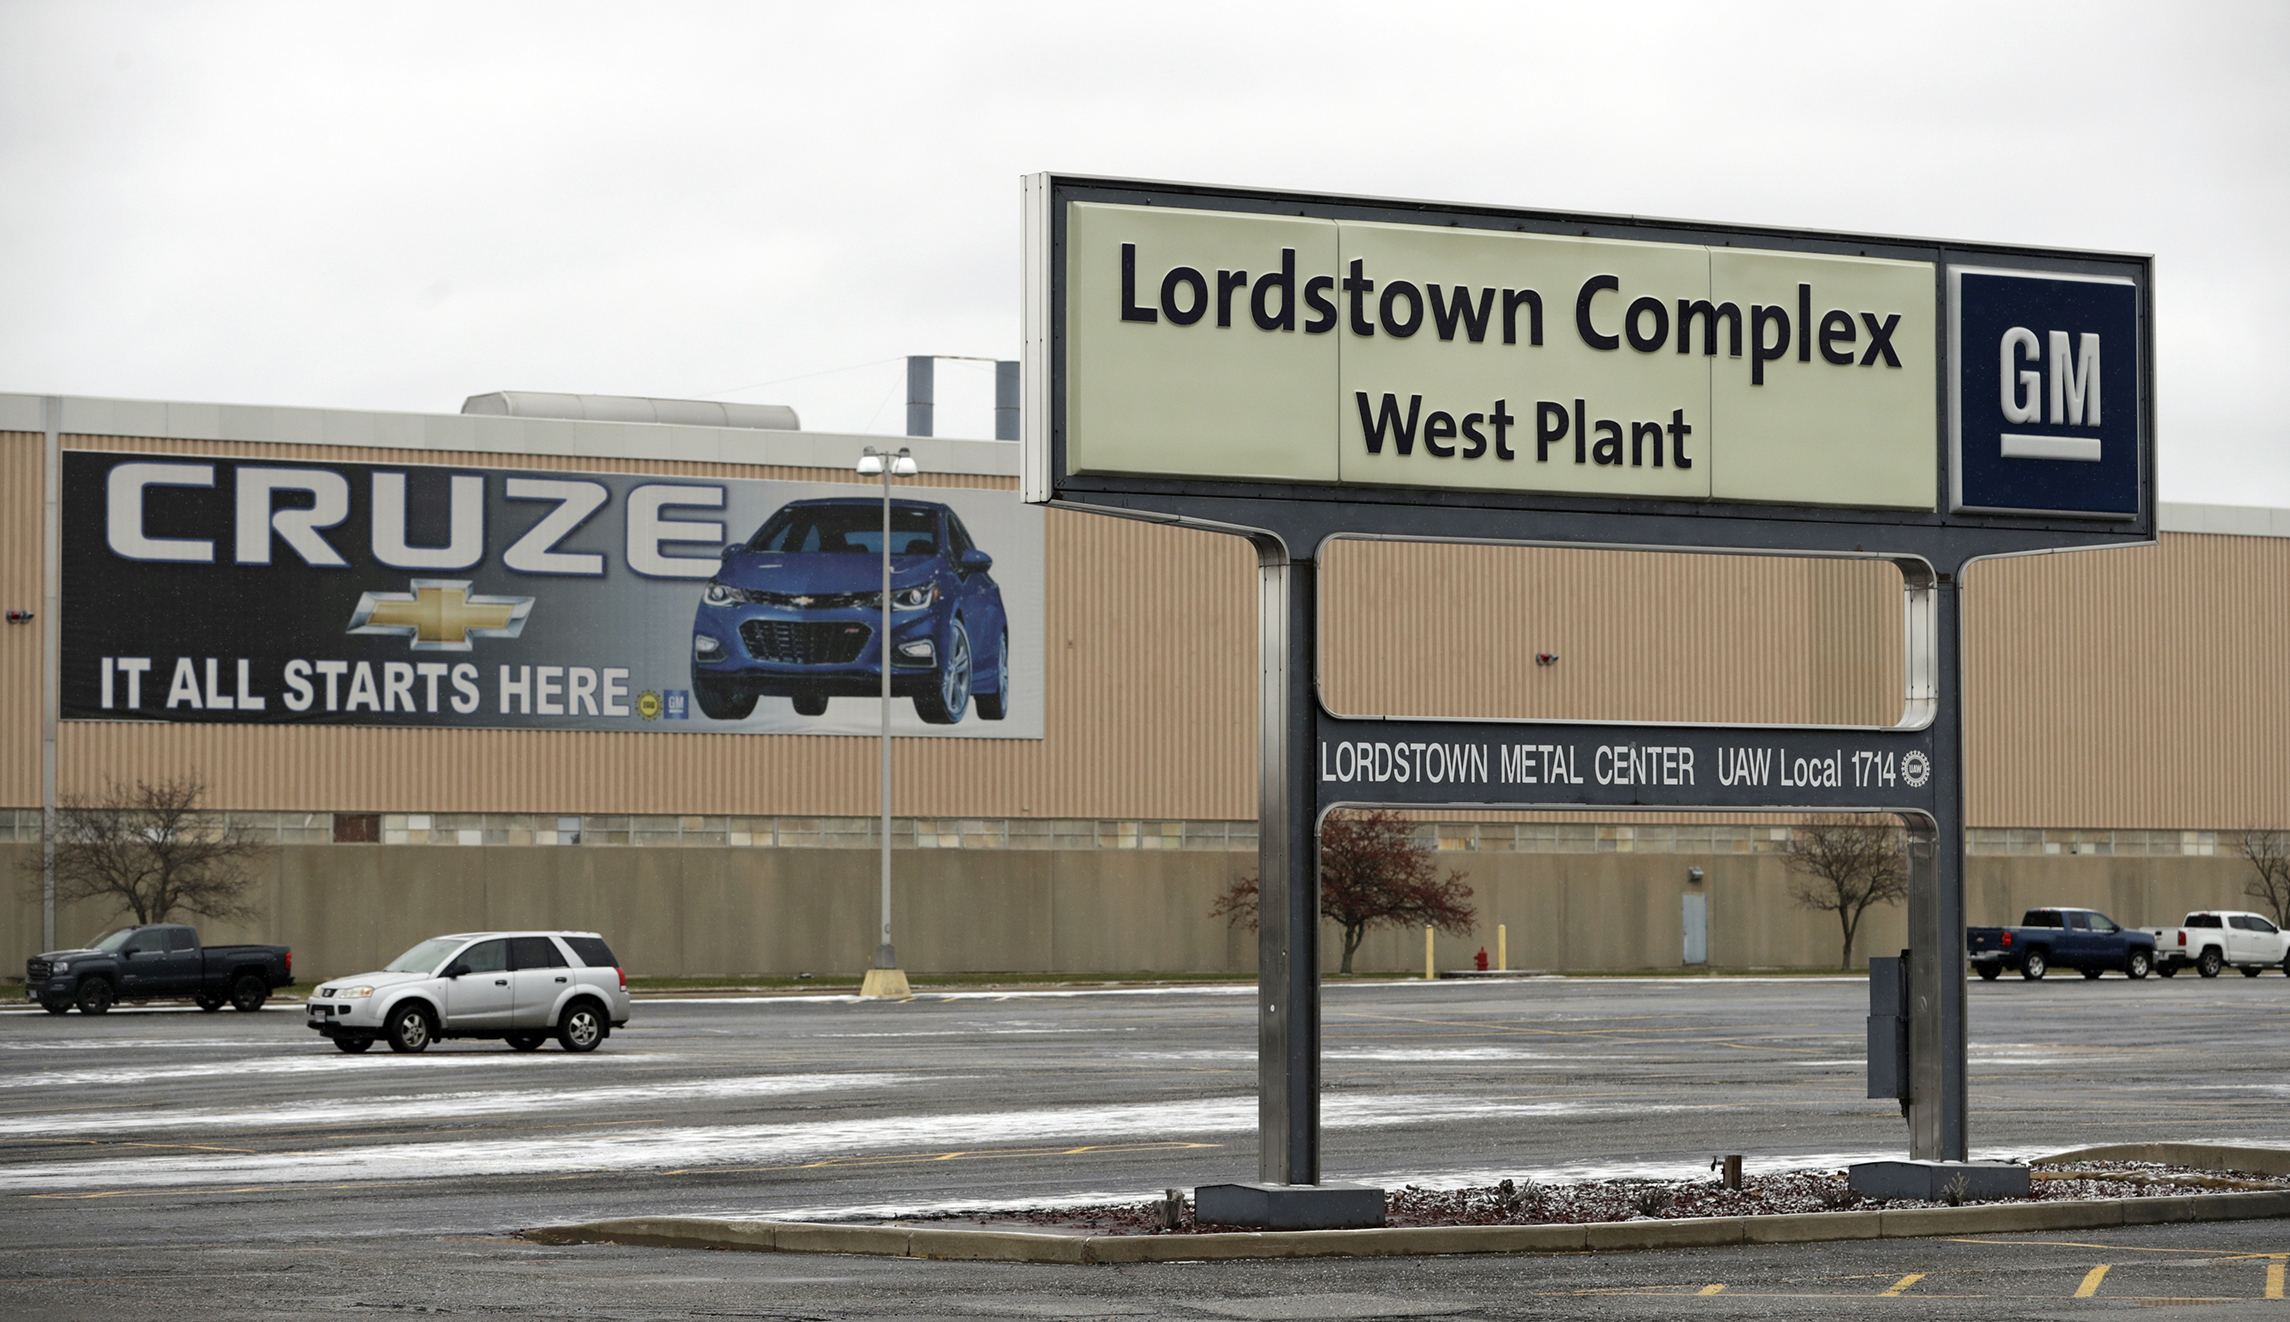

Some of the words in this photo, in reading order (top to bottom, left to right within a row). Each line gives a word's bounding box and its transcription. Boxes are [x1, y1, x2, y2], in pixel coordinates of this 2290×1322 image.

[1120, 242, 1544, 346] Lordstown
[1575, 274, 1903, 386] Complex
[2000, 326, 2101, 427] GM
[1355, 390, 1514, 461] West
[1536, 398, 1692, 468] Plant
[106, 462, 725, 579] CRUZE
[101, 657, 151, 709] IT
[166, 657, 265, 710] ALL
[282, 659, 481, 714] STARTS
[499, 664, 631, 718] HERE
[668, 696, 684, 709] GM
[1322, 741, 1488, 783] LORDSTOWN
[1501, 744, 1584, 784] METAL
[1594, 745, 1695, 786] CENTER
[1718, 747, 1772, 786] UAW
[1780, 748, 1842, 788] Local
[1850, 750, 1897, 788] 1714
[1908, 764, 1923, 774] UAW
